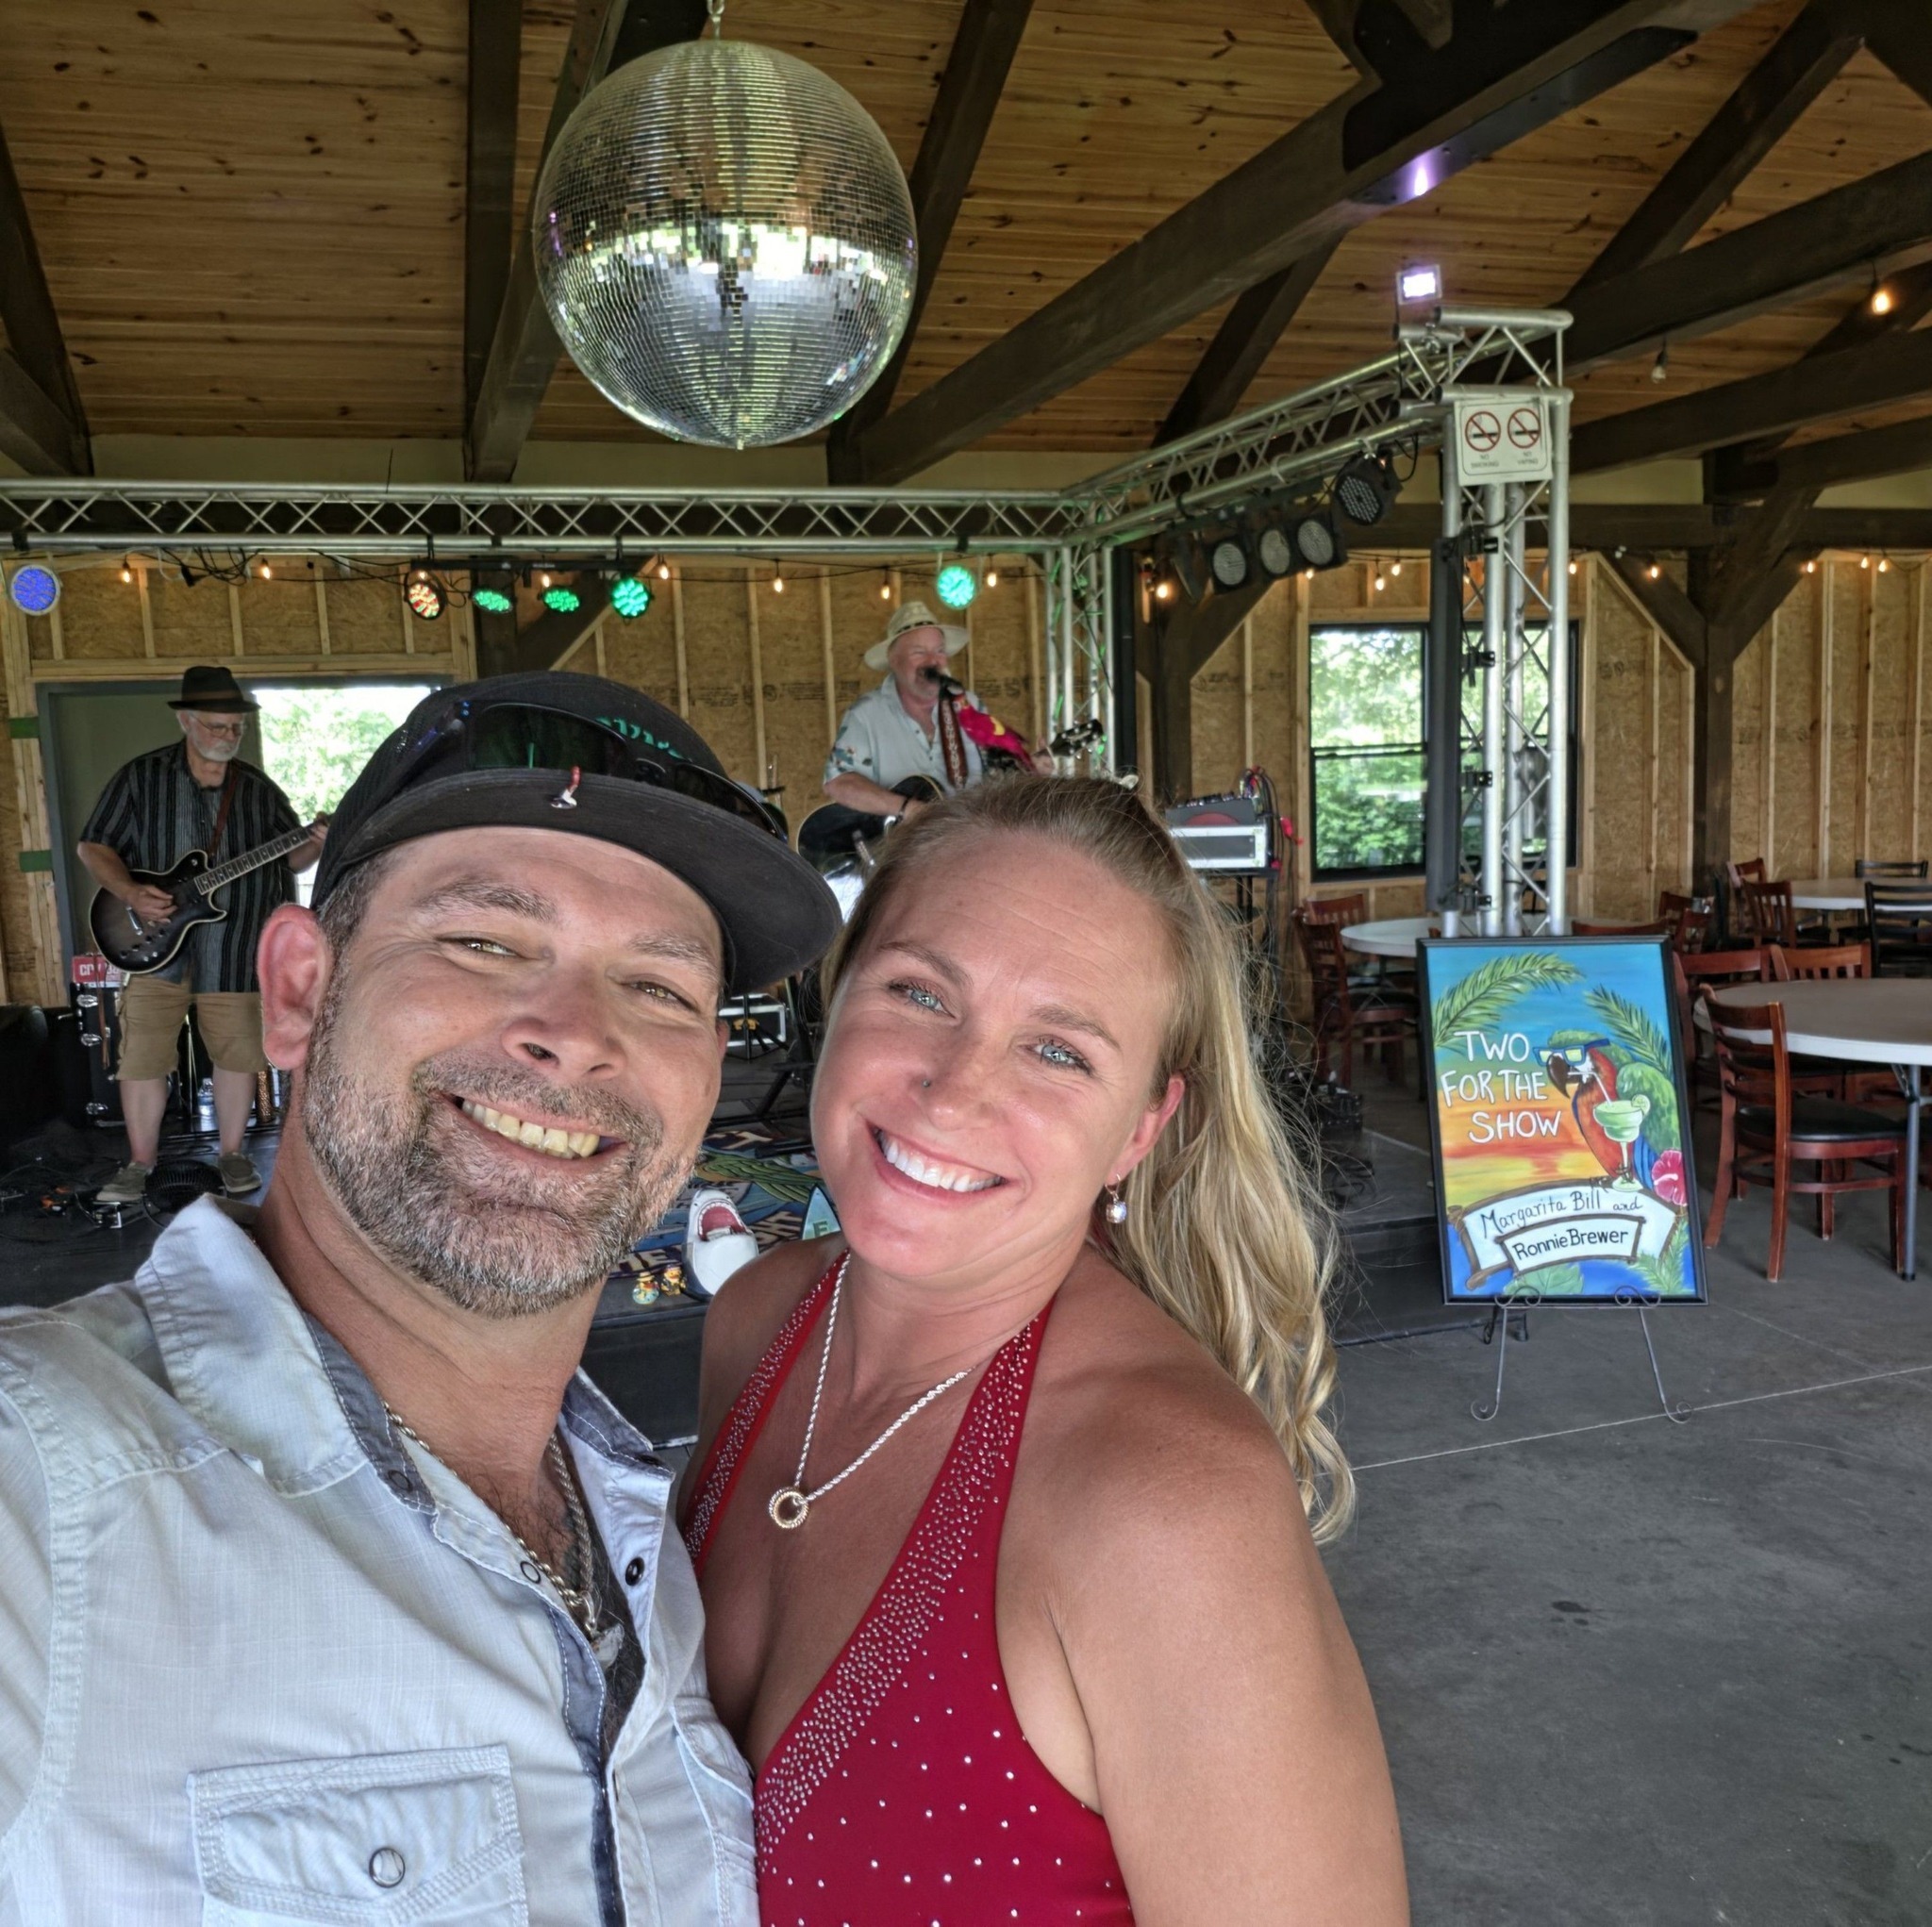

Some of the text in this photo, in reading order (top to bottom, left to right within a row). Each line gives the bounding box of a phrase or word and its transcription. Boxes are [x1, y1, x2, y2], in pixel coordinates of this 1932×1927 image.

[1453, 1030, 1530, 1063] TWO
[1440, 1069, 1549, 1108] FOR THE
[1468, 1109, 1562, 1144] SHOW
[1480, 1188, 1644, 1239] Margarita Bill and
